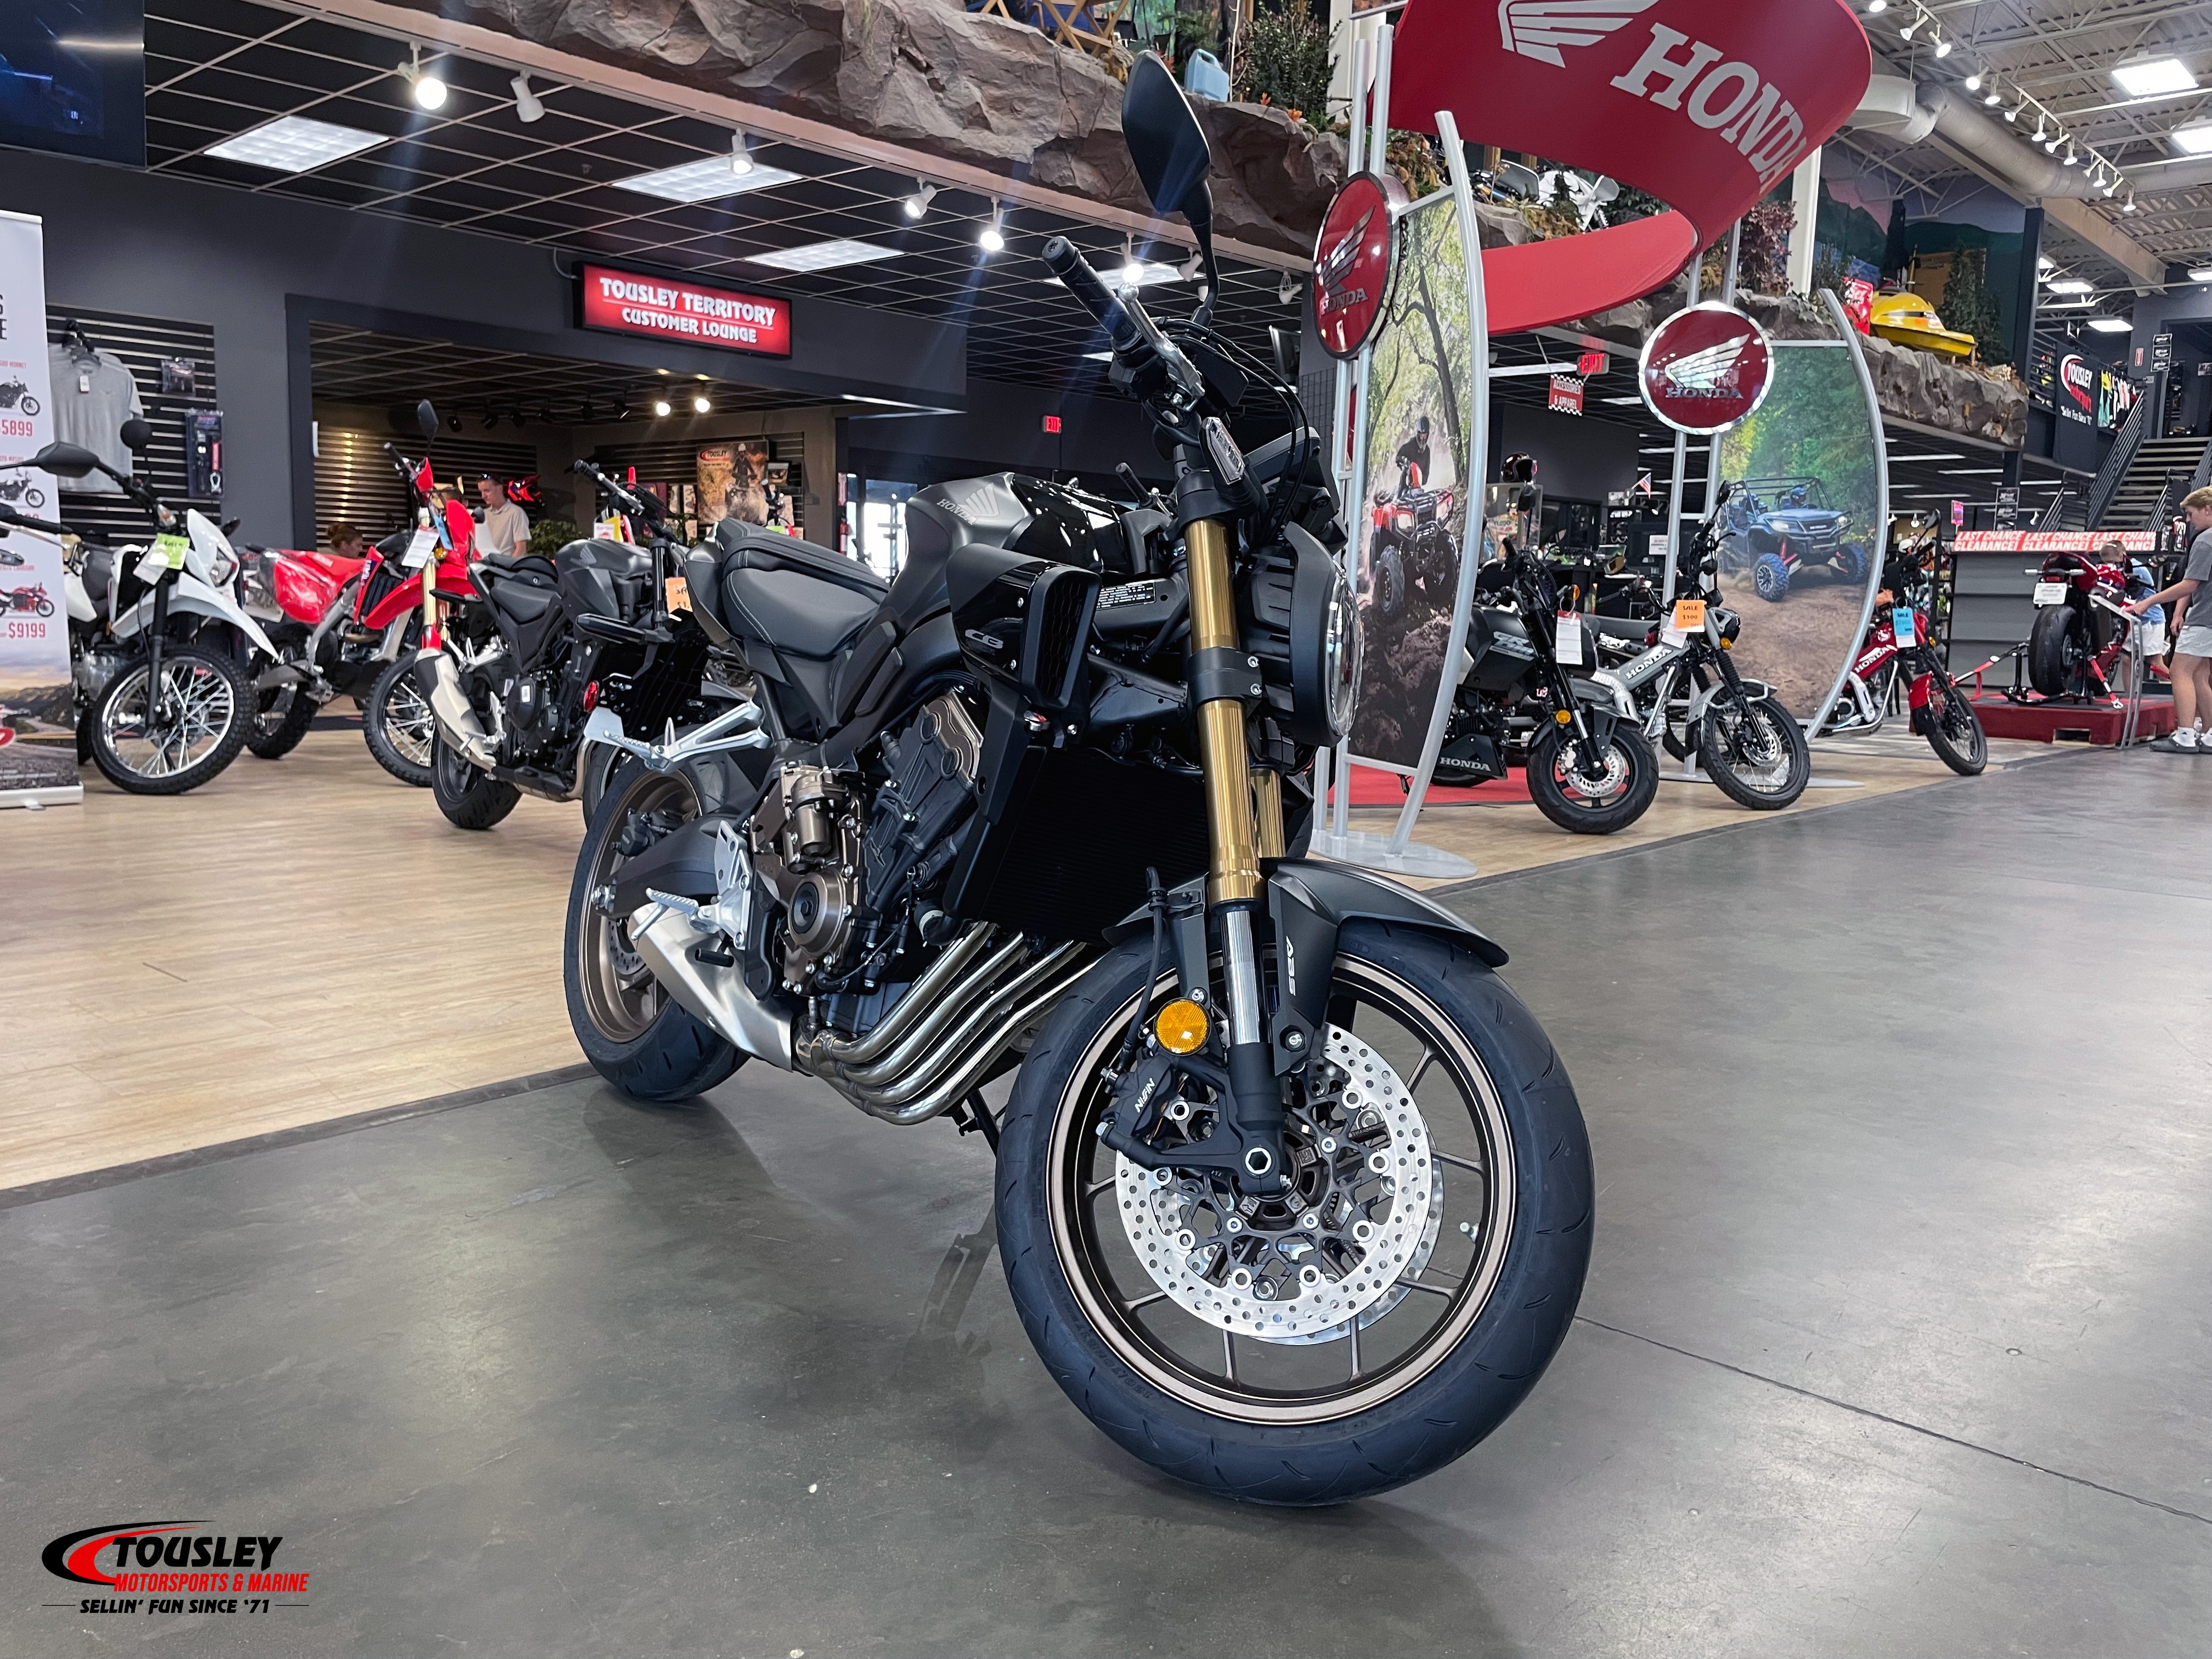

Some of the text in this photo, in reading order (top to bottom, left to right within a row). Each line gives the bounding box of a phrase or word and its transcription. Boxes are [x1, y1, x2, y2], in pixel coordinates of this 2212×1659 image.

[1610, 22, 1807, 195] HONDA
[600, 277, 776, 327] TOUSLEY TERRITORY
[622, 307, 757, 343] CUSTOMER LOUNGE
[1581, 354, 1605, 374] EXIT
[2067, 362, 2092, 390] TOUSLEY
[1559, 396, 1577, 410] APPAREL
[1666, 387, 1743, 399] HONDA
[0, 419, 33, 437] 5899
[936, 498, 977, 526] HONDA
[1954, 541, 2018, 551] CLEARANCE!
[1956, 531, 2025, 541] LAST CHANCE
[2022, 541, 2090, 551] CLEARANCE!
[2024, 532, 2094, 541] LAST CHANCE
[2094, 532, 2124, 541] LAST
[9, 622, 46, 639] $9199
[965, 629, 1003, 649] CB
[1625, 648, 1673, 680] HONDA
[1855, 646, 1891, 673] HONDA
[1440, 757, 1491, 772] HONDA
[1286, 935, 1296, 996] ABS
[1135, 1077, 1155, 1113] NISSIN
